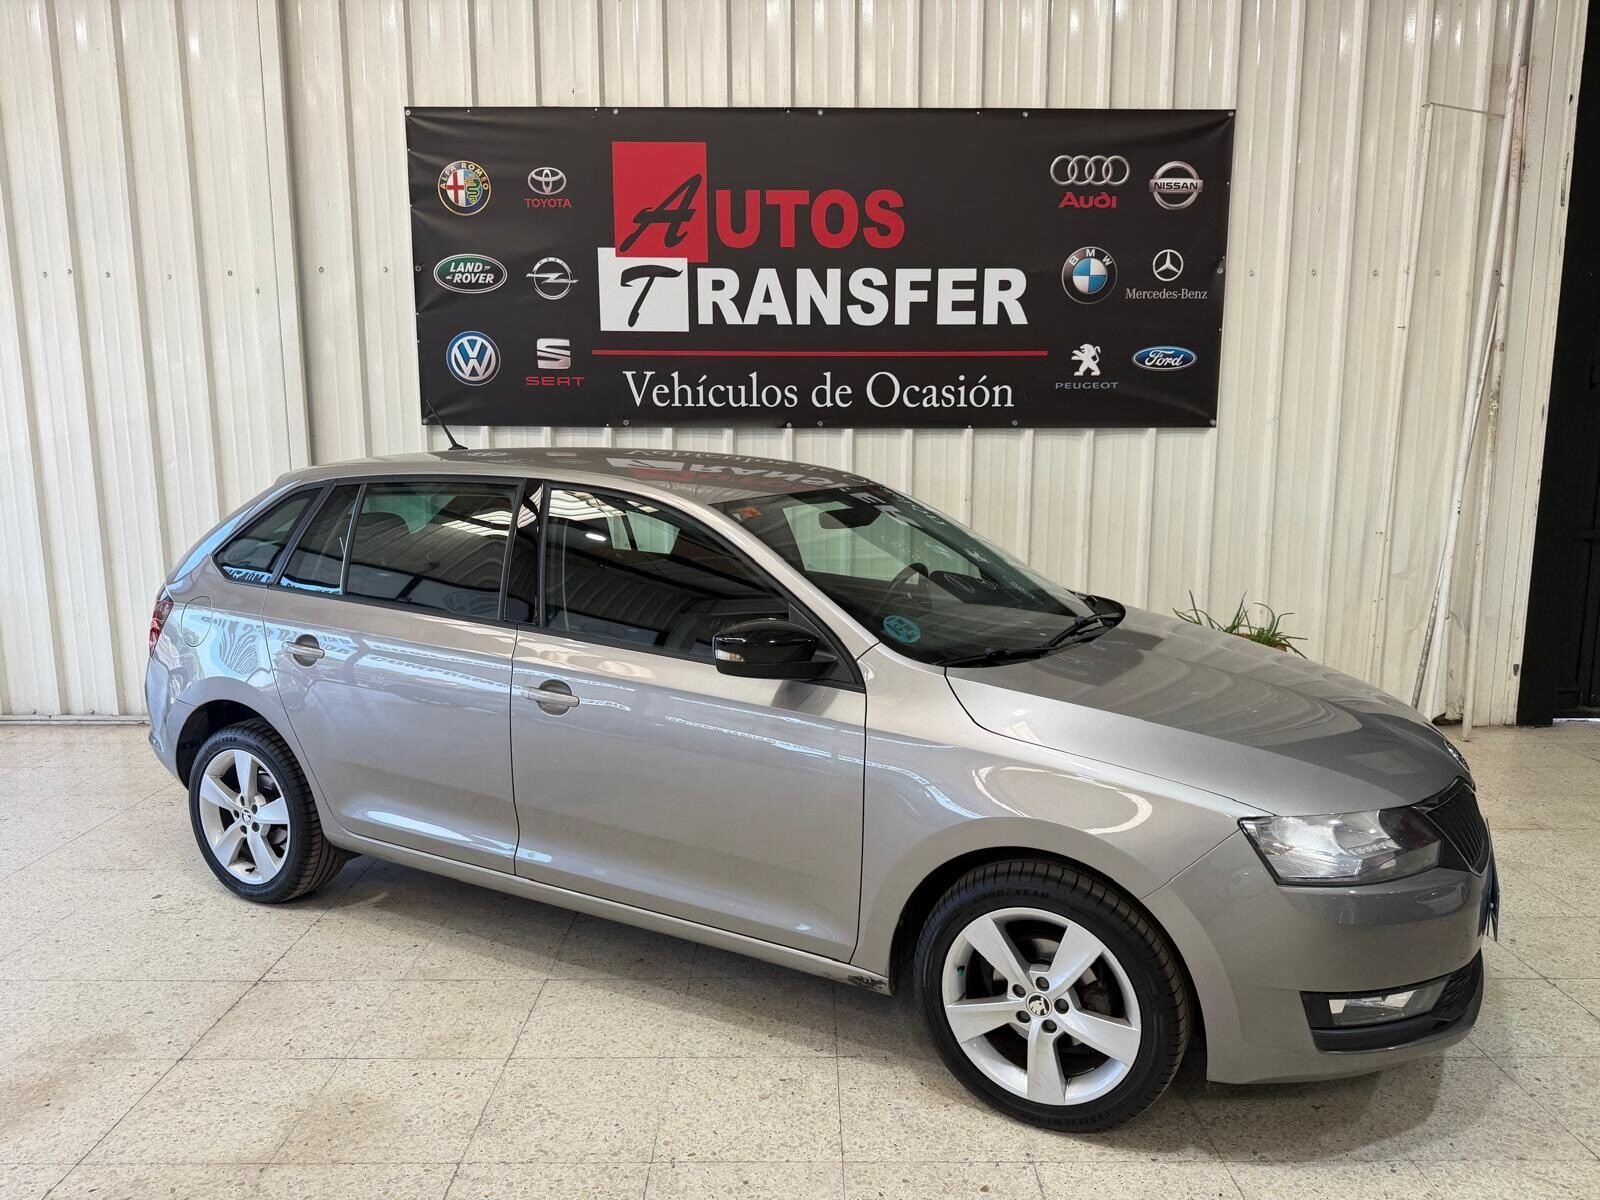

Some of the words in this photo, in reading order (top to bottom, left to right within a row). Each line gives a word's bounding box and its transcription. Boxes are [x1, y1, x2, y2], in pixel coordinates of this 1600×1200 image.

[440, 165, 457, 189] ALFA
[461, 162, 490, 191] ROMEO
[1153, 182, 1198, 190] NISSAN
[524, 198, 572, 208] TOYOTA
[1058, 192, 1118, 208] Audi
[619, 174, 905, 252] AUTOS
[1068, 249, 1113, 267] BMW
[620, 264, 1029, 328] TRANSFER
[1125, 288, 1208, 300] Mercedes-Benz
[1145, 350, 1184, 367] Ford
[525, 376, 585, 386] SEAT
[622, 370, 798, 408] Vehículos
[811, 371, 853, 408] de
[866, 371, 1015, 408] Ocasión
[1055, 382, 1119, 390] PEUGEOT
